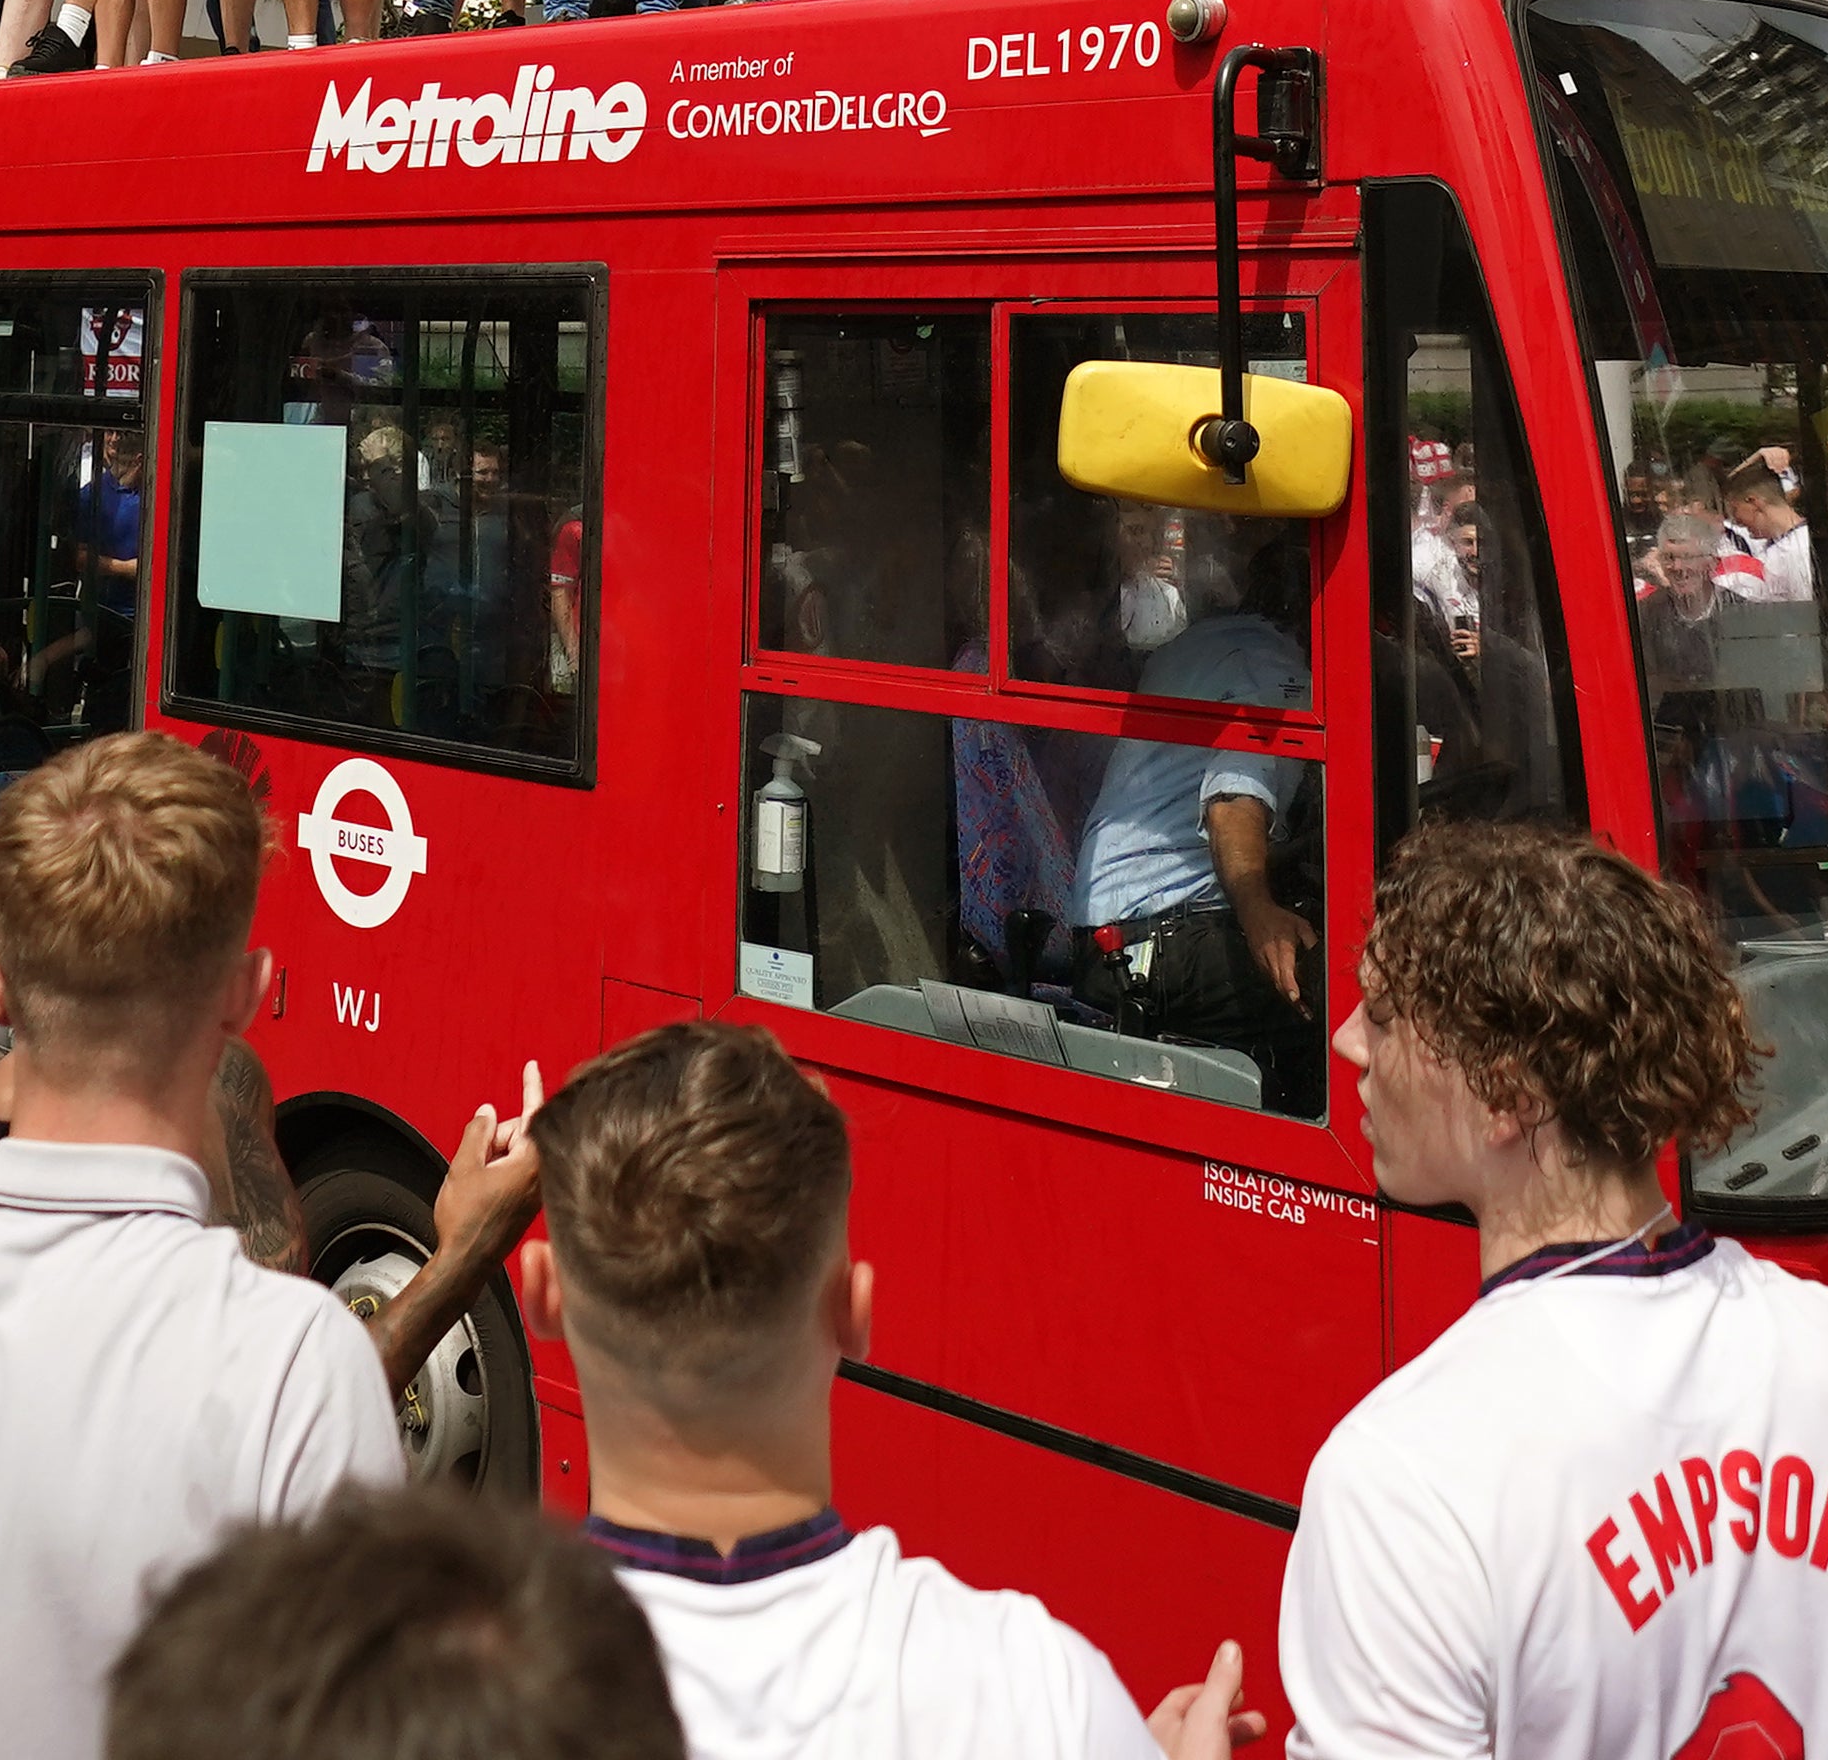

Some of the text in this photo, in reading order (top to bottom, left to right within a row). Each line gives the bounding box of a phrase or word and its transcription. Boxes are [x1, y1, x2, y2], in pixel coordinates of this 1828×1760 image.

[669, 52, 795, 84] A member of
[305, 64, 648, 174] Metroline
[337, 829, 384, 856] BUSES
[333, 981, 380, 1033] WJ
[1204, 1160, 1376, 1221] ISOLATOR SWITCH
[1204, 1182, 1306, 1225] INSIDE CAB
